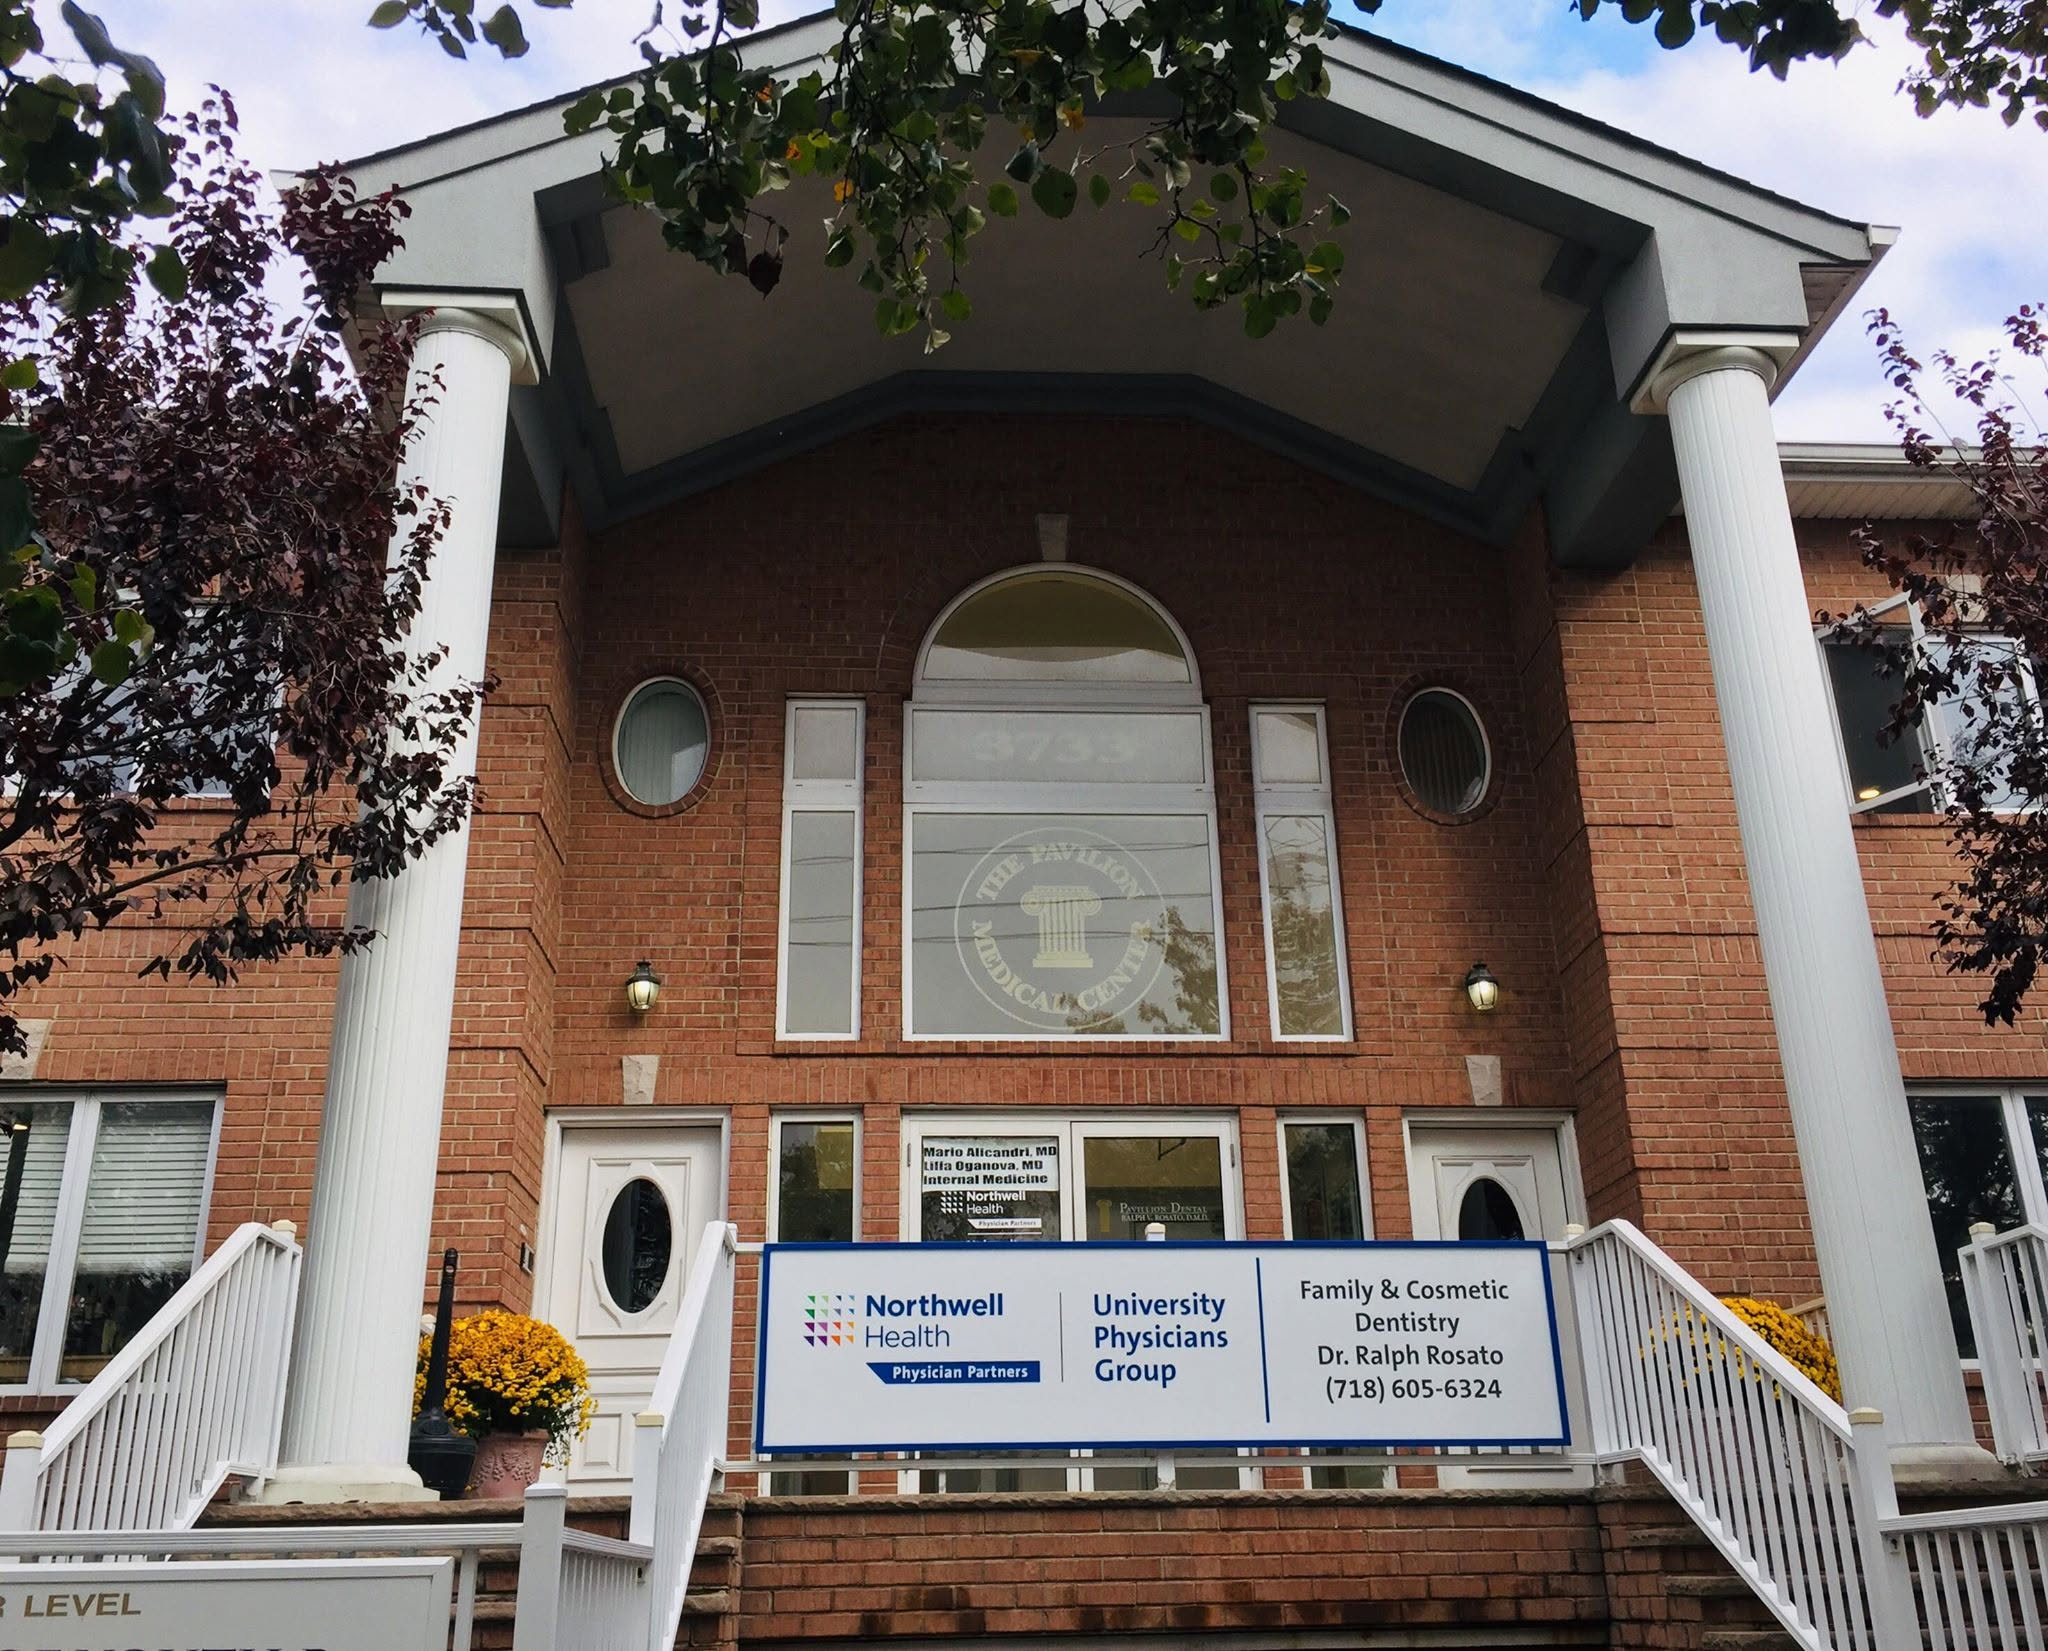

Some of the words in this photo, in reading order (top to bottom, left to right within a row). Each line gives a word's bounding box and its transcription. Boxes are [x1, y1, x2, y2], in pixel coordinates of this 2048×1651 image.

[976, 854, 1025, 900] THE
[1031, 842, 1145, 900] PAVILION
[972, 920, 1070, 1014] MEDICAL
[1078, 920, 1152, 1011] CENTER
[923, 1147, 964, 1158] Mario
[966, 1147, 1033, 1158] Alicandri,
[1036, 1146, 1058, 1157] MD
[955, 1160, 1020, 1172] Oganova,
[1022, 1159, 1044, 1170] MD
[923, 1174, 980, 1185] Internal
[982, 1174, 1049, 1185] Medicine
[966, 1190, 1026, 1202] Northwell
[966, 1203, 1004, 1215] Health
[865, 1292, 1004, 1318] Northwell
[1300, 1278, 1374, 1307] Family
[1381, 1278, 1400, 1300] &
[1406, 1278, 1510, 1300] Cosmetic
[1093, 1291, 1227, 1323] University
[865, 1323, 951, 1349] Health
[1354, 1310, 1461, 1339] Dentistry
[1093, 1324, 1229, 1354] Physicians
[1317, 1345, 1349, 1367] Dr.
[1355, 1343, 1420, 1371] Ralph
[1426, 1344, 1504, 1367] Rosato
[891, 1365, 962, 1382] Physician
[967, 1365, 1030, 1380] Partners
[1094, 1358, 1177, 1389] Group
[1325, 1376, 1386, 1405] (718)
[1391, 1378, 1503, 1400] 605-6324
[23, 1592, 142, 1618] LEVEL
